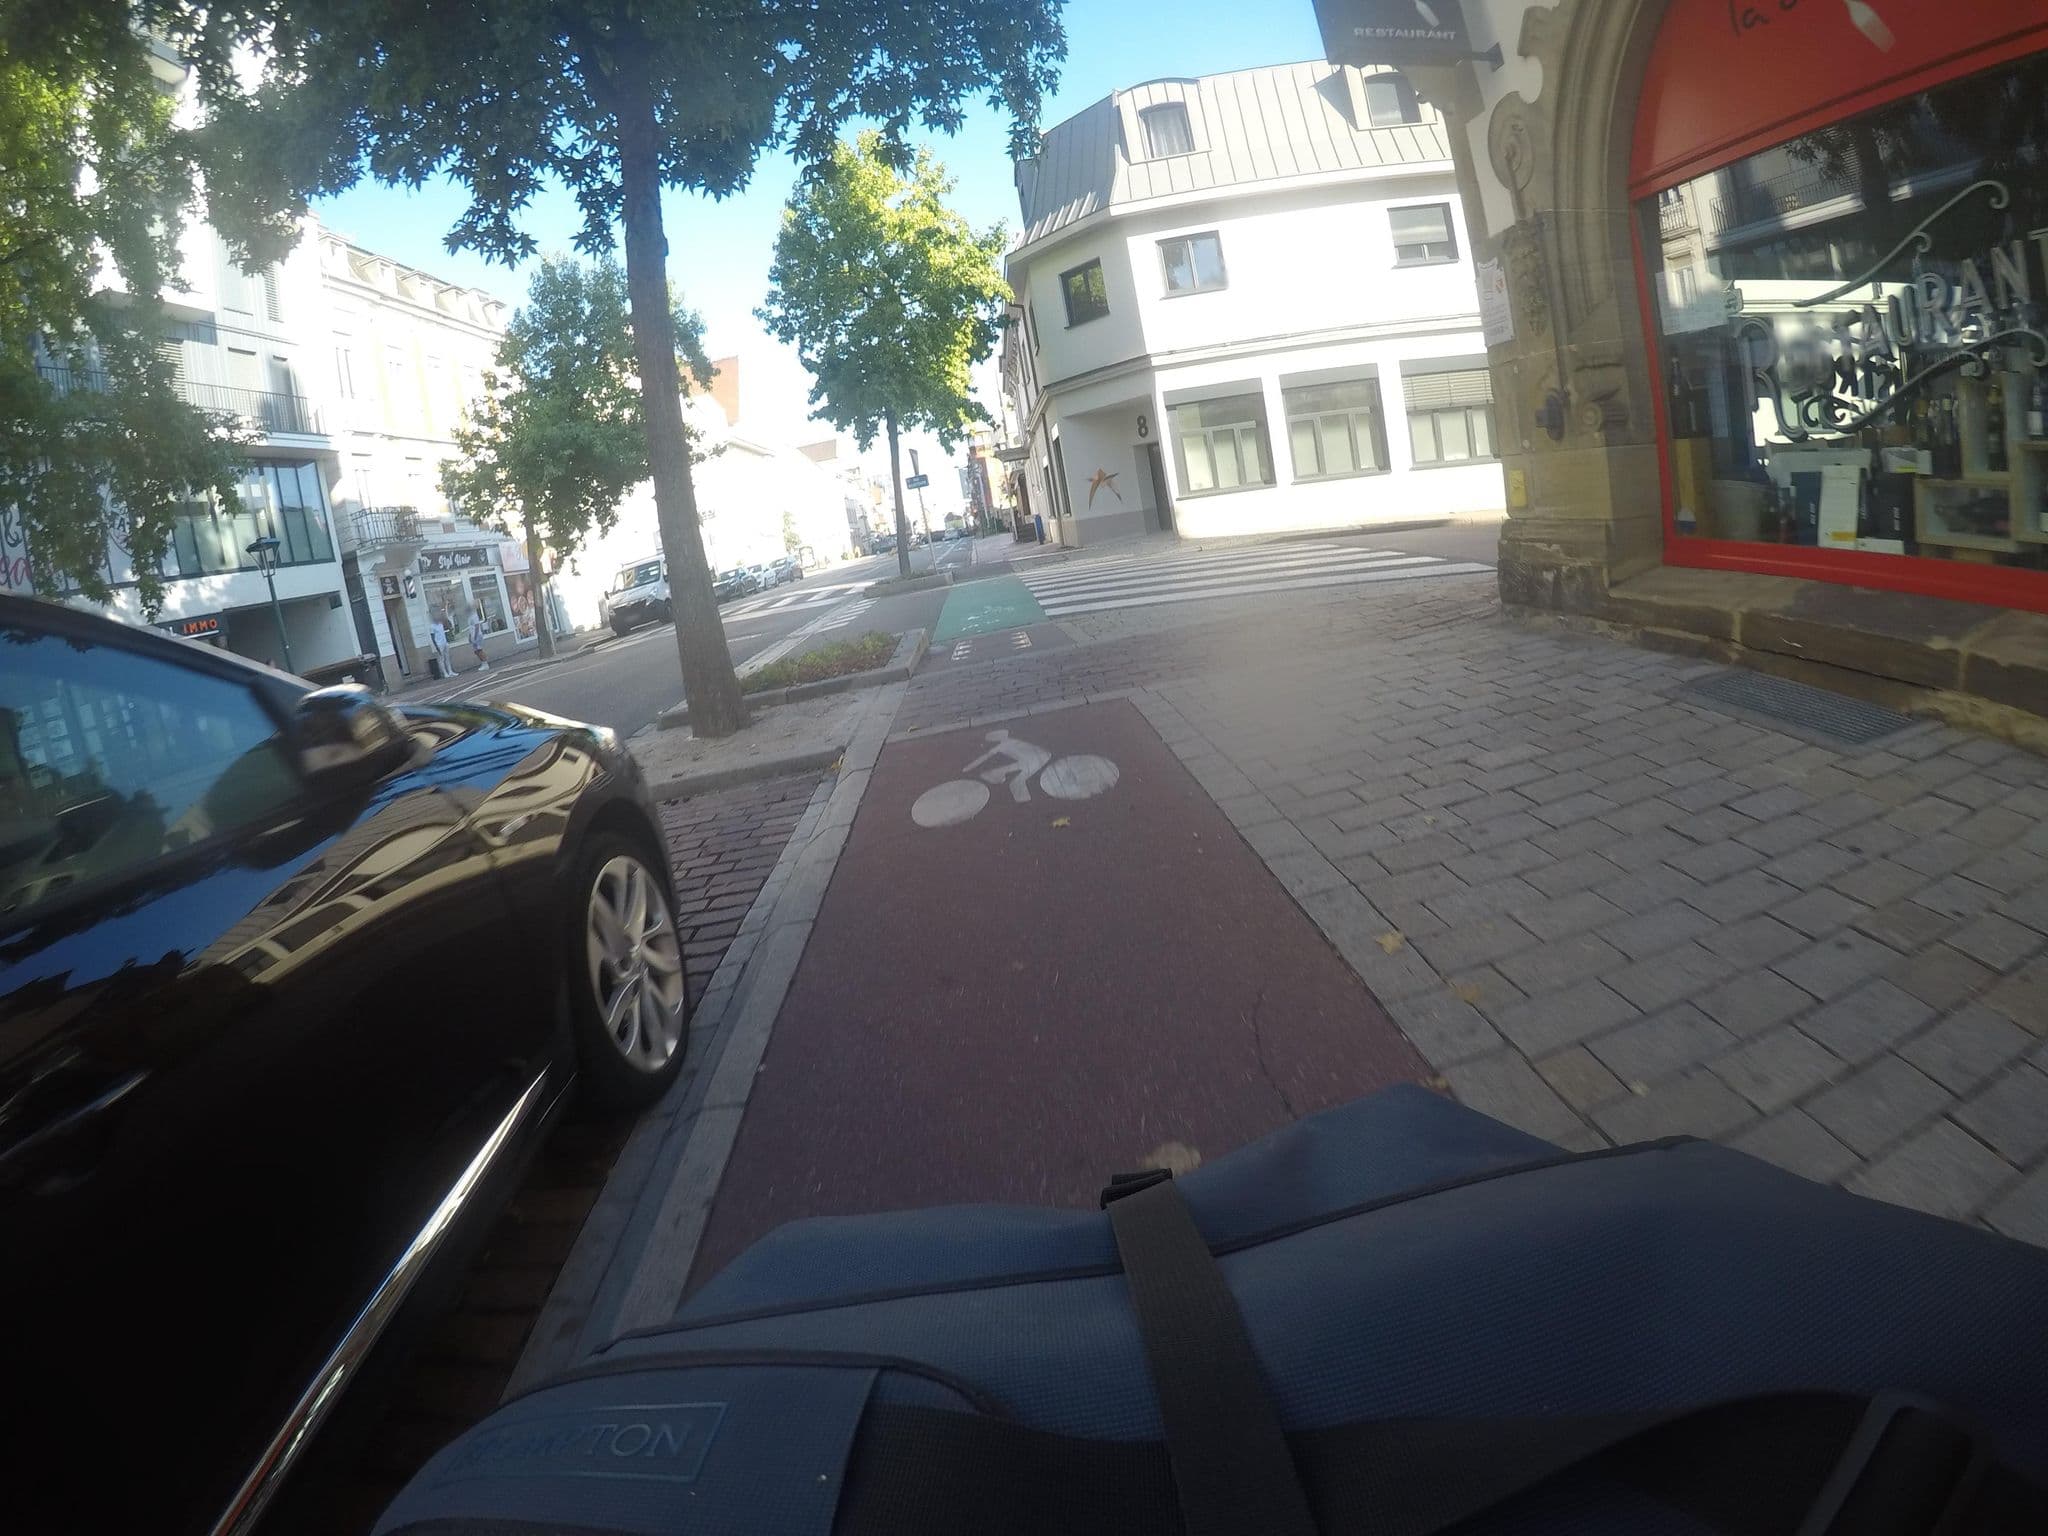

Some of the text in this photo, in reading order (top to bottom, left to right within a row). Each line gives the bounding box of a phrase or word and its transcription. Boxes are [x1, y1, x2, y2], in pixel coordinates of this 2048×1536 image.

[1353, 27, 1457, 41] RESTAURANT
[1136, 415, 1149, 438] 8
[183, 618, 218, 634] IMMO
